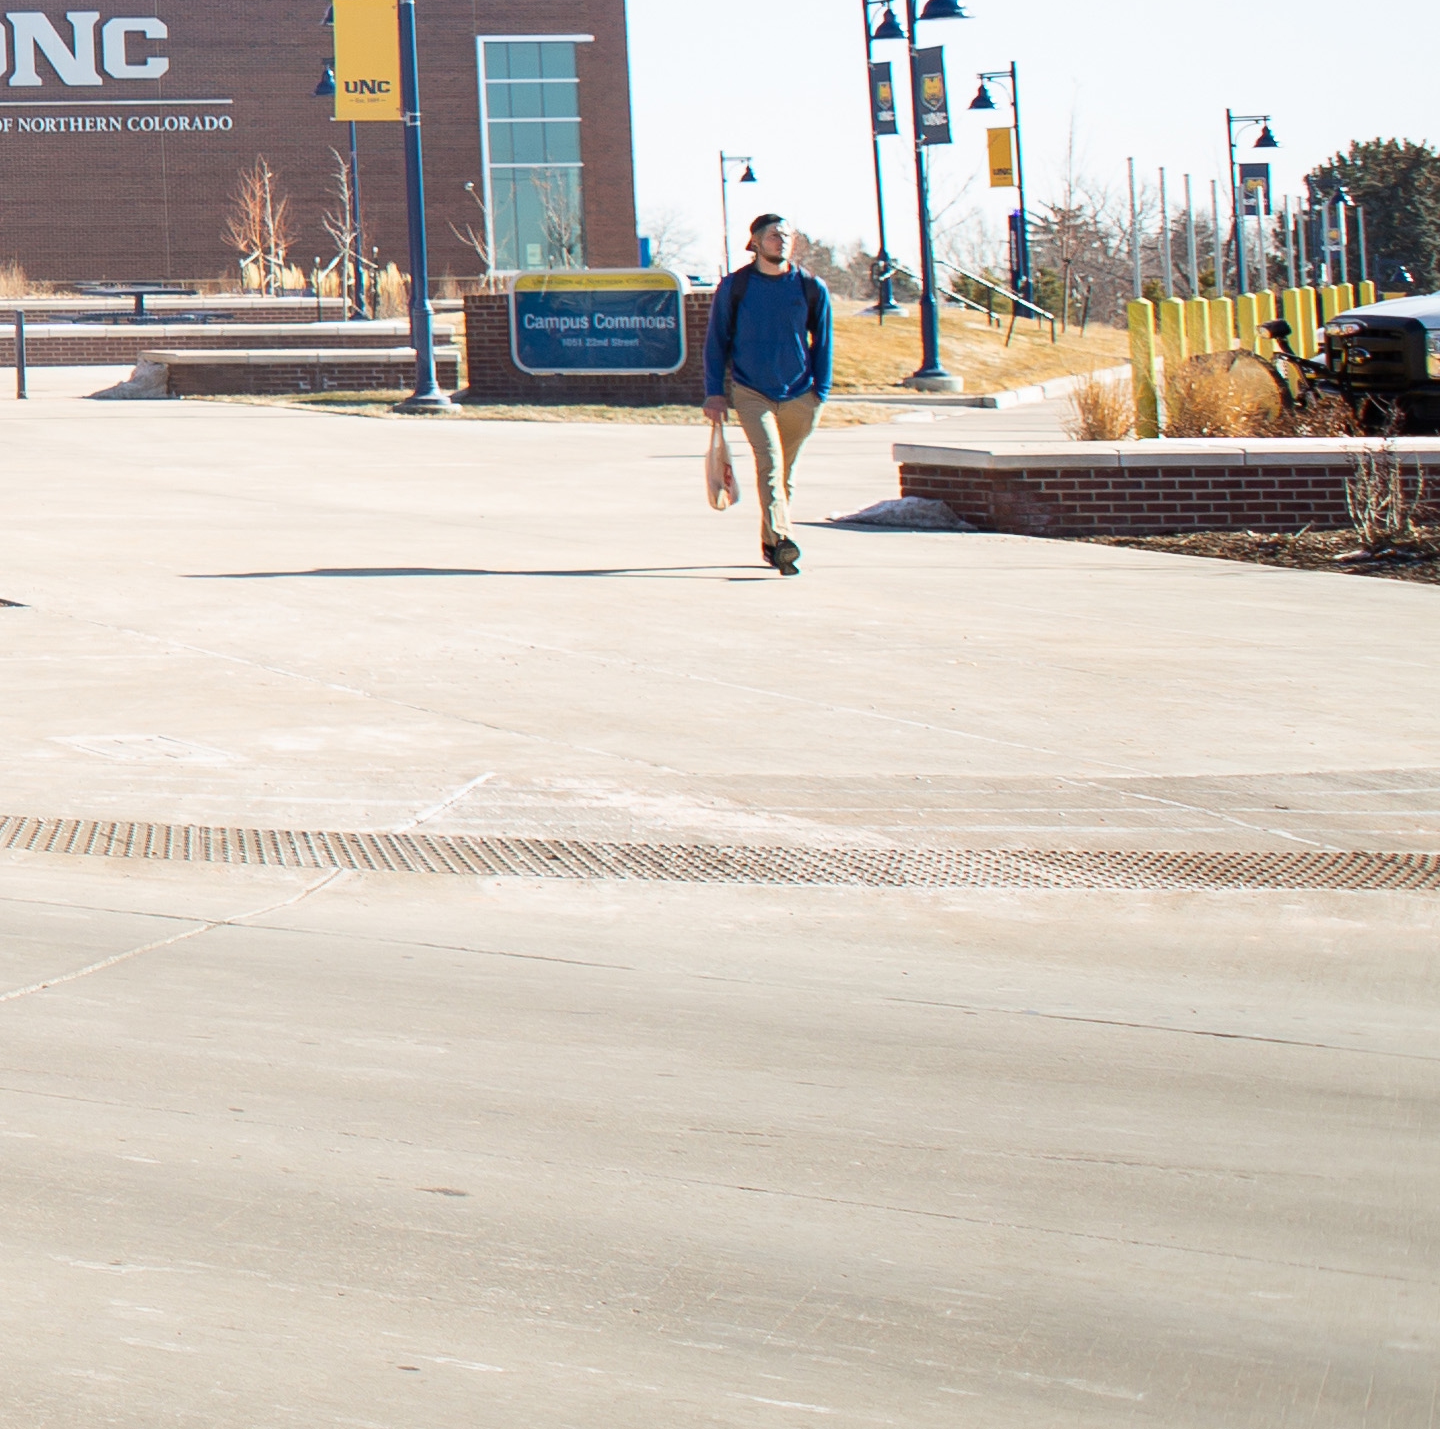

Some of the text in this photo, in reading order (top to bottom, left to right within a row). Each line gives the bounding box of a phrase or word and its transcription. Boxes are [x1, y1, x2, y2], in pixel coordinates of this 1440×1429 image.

[343, 79, 391, 95] UNC
[17, 116, 122, 133] NORTHERN
[126, 115, 233, 132] COLORADO
[523, 312, 677, 332] Campus Commons
